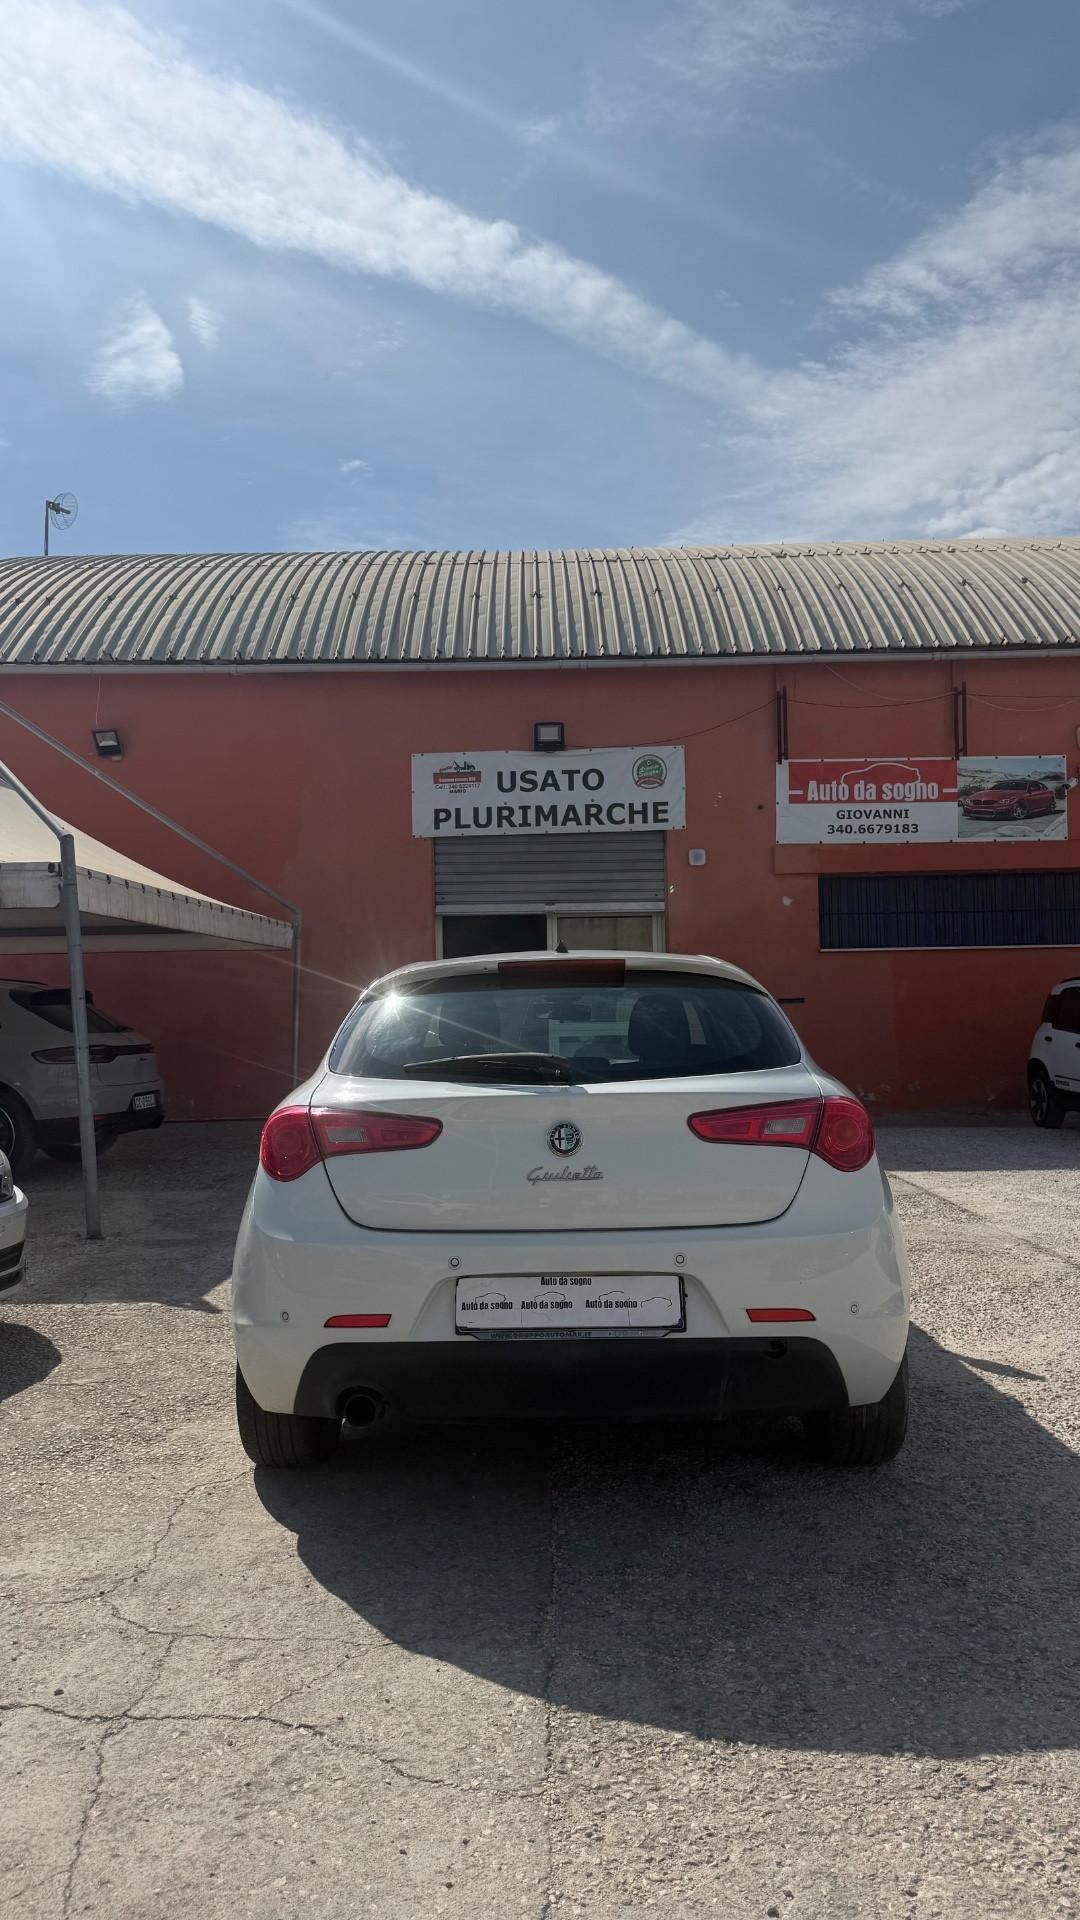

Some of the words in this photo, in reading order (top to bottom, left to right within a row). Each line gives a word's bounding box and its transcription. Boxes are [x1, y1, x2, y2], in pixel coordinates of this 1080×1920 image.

[496, 768, 605, 793] USATO
[807, 780, 849, 801] Auto
[853, 780, 875, 801] da
[881, 781, 939, 801] sogno
[433, 801, 669, 830] PLURIMARCHE
[836, 808, 910, 820] GIOVANNI
[827, 823, 919, 835] 340.6679183
[540, 1277, 558, 1286] Auto
[559, 1277, 568, 1286] da
[569, 1277, 592, 1286] sogno
[461, 1302, 478, 1311] Auto
[479, 1302, 489, 1310] da
[490, 1302, 513, 1310] sogno
[521, 1301, 538, 1310] Auto
[539, 1301, 549, 1309] da
[550, 1301, 573, 1310] sogno
[585, 1299, 602, 1309] Auto
[603, 1299, 613, 1308] da
[614, 1299, 638, 1308] sogno
